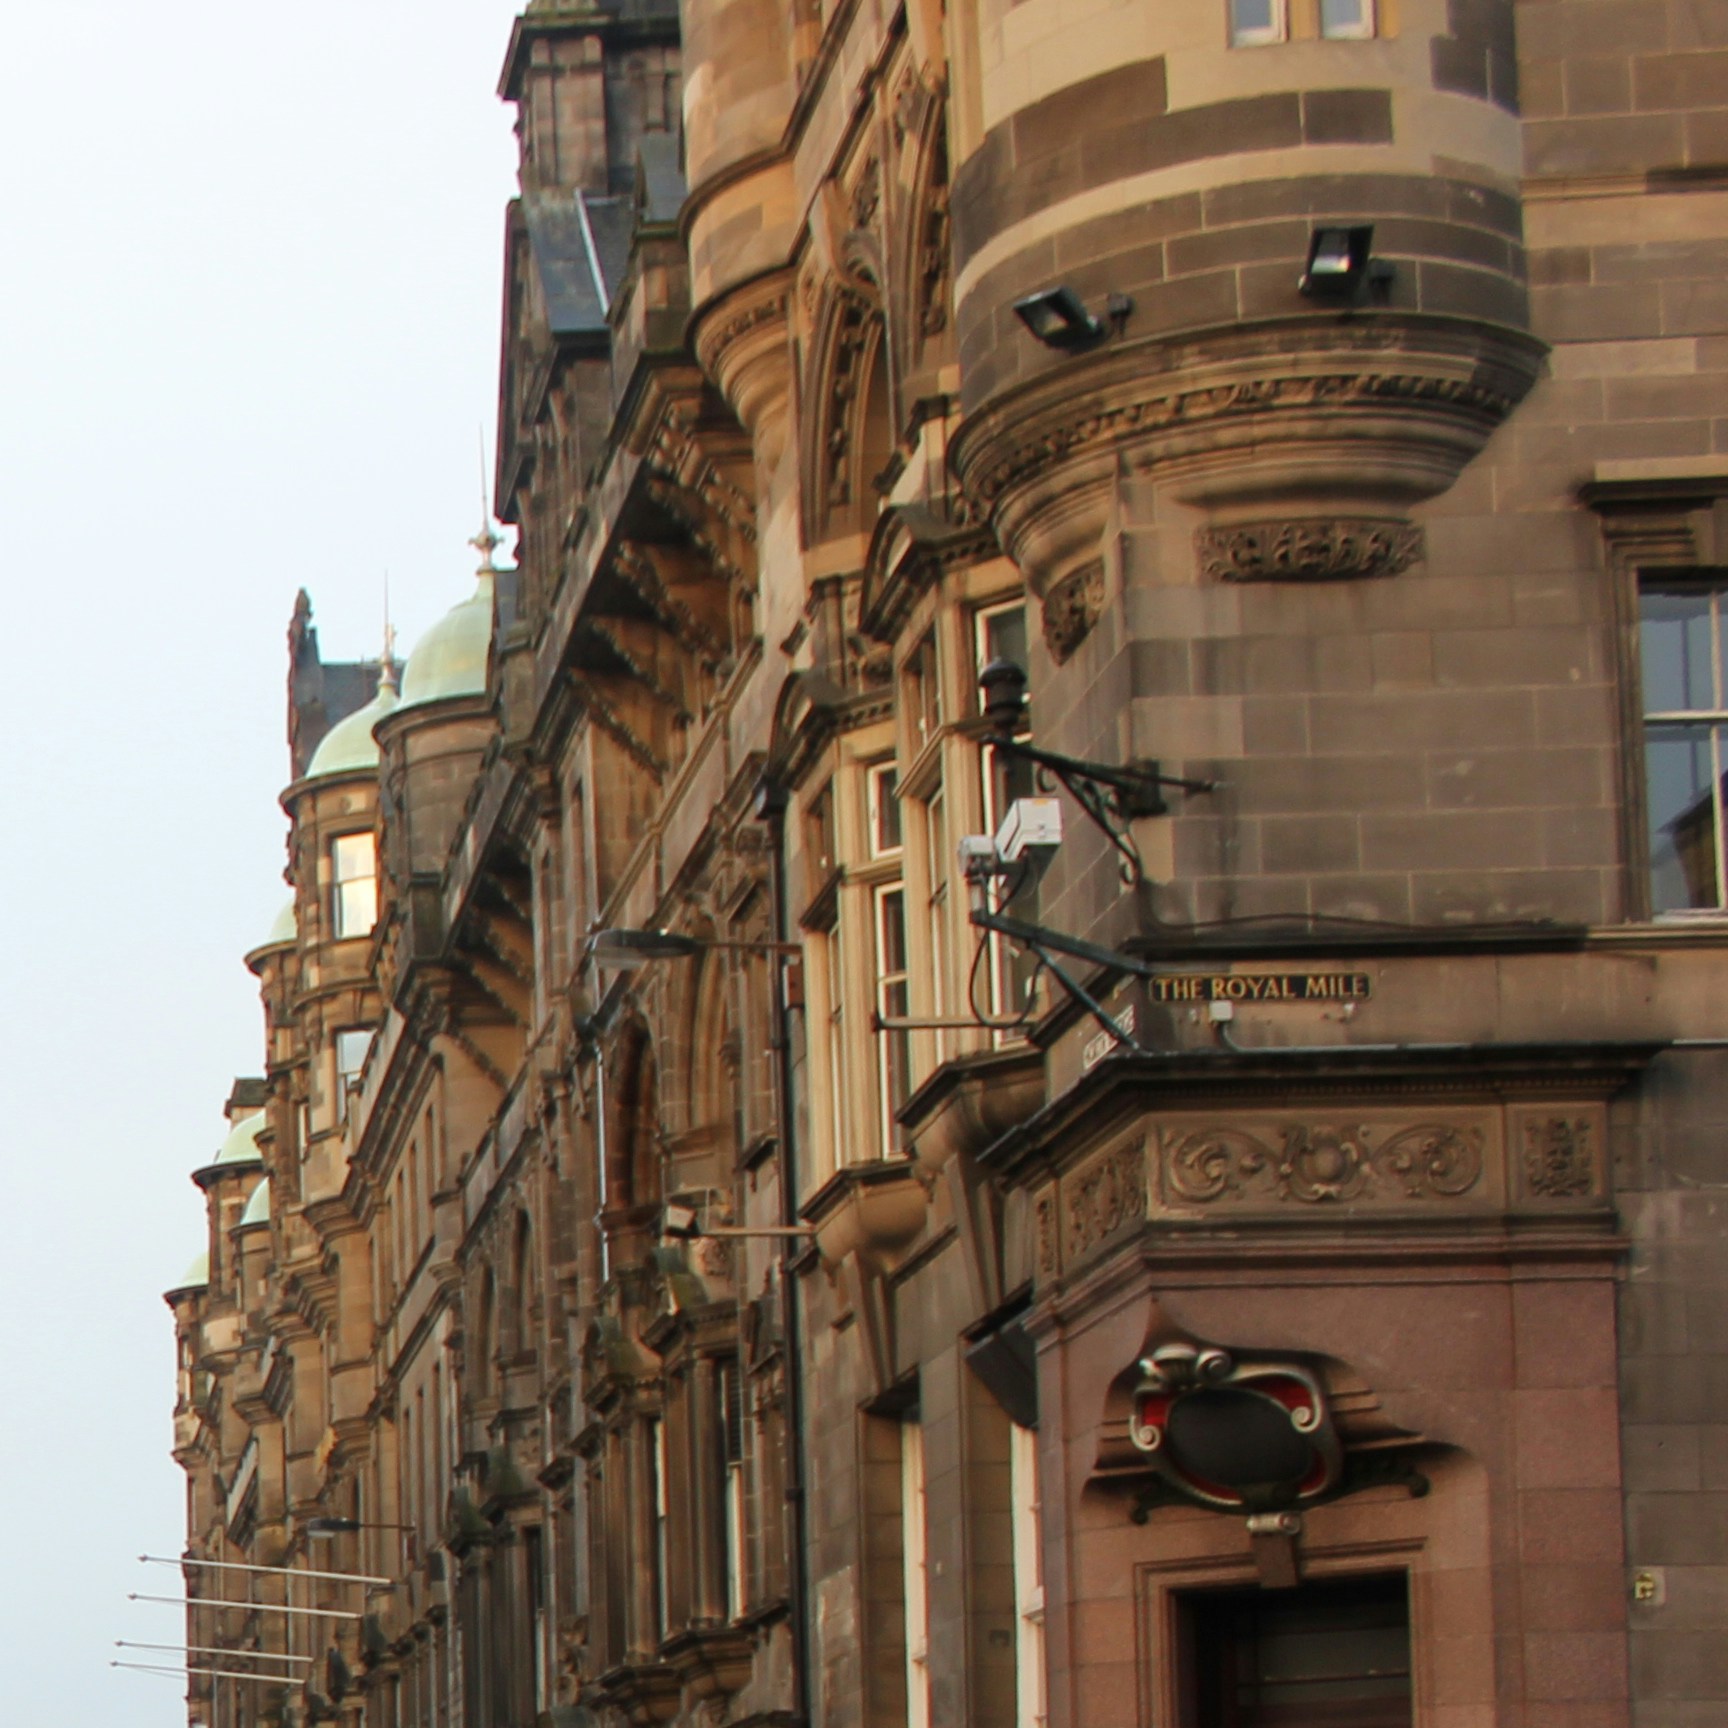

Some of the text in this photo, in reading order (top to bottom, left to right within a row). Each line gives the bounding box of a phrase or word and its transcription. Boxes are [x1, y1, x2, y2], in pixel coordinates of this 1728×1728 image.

[1156, 974, 1366, 999] THE ROYAL MILE
